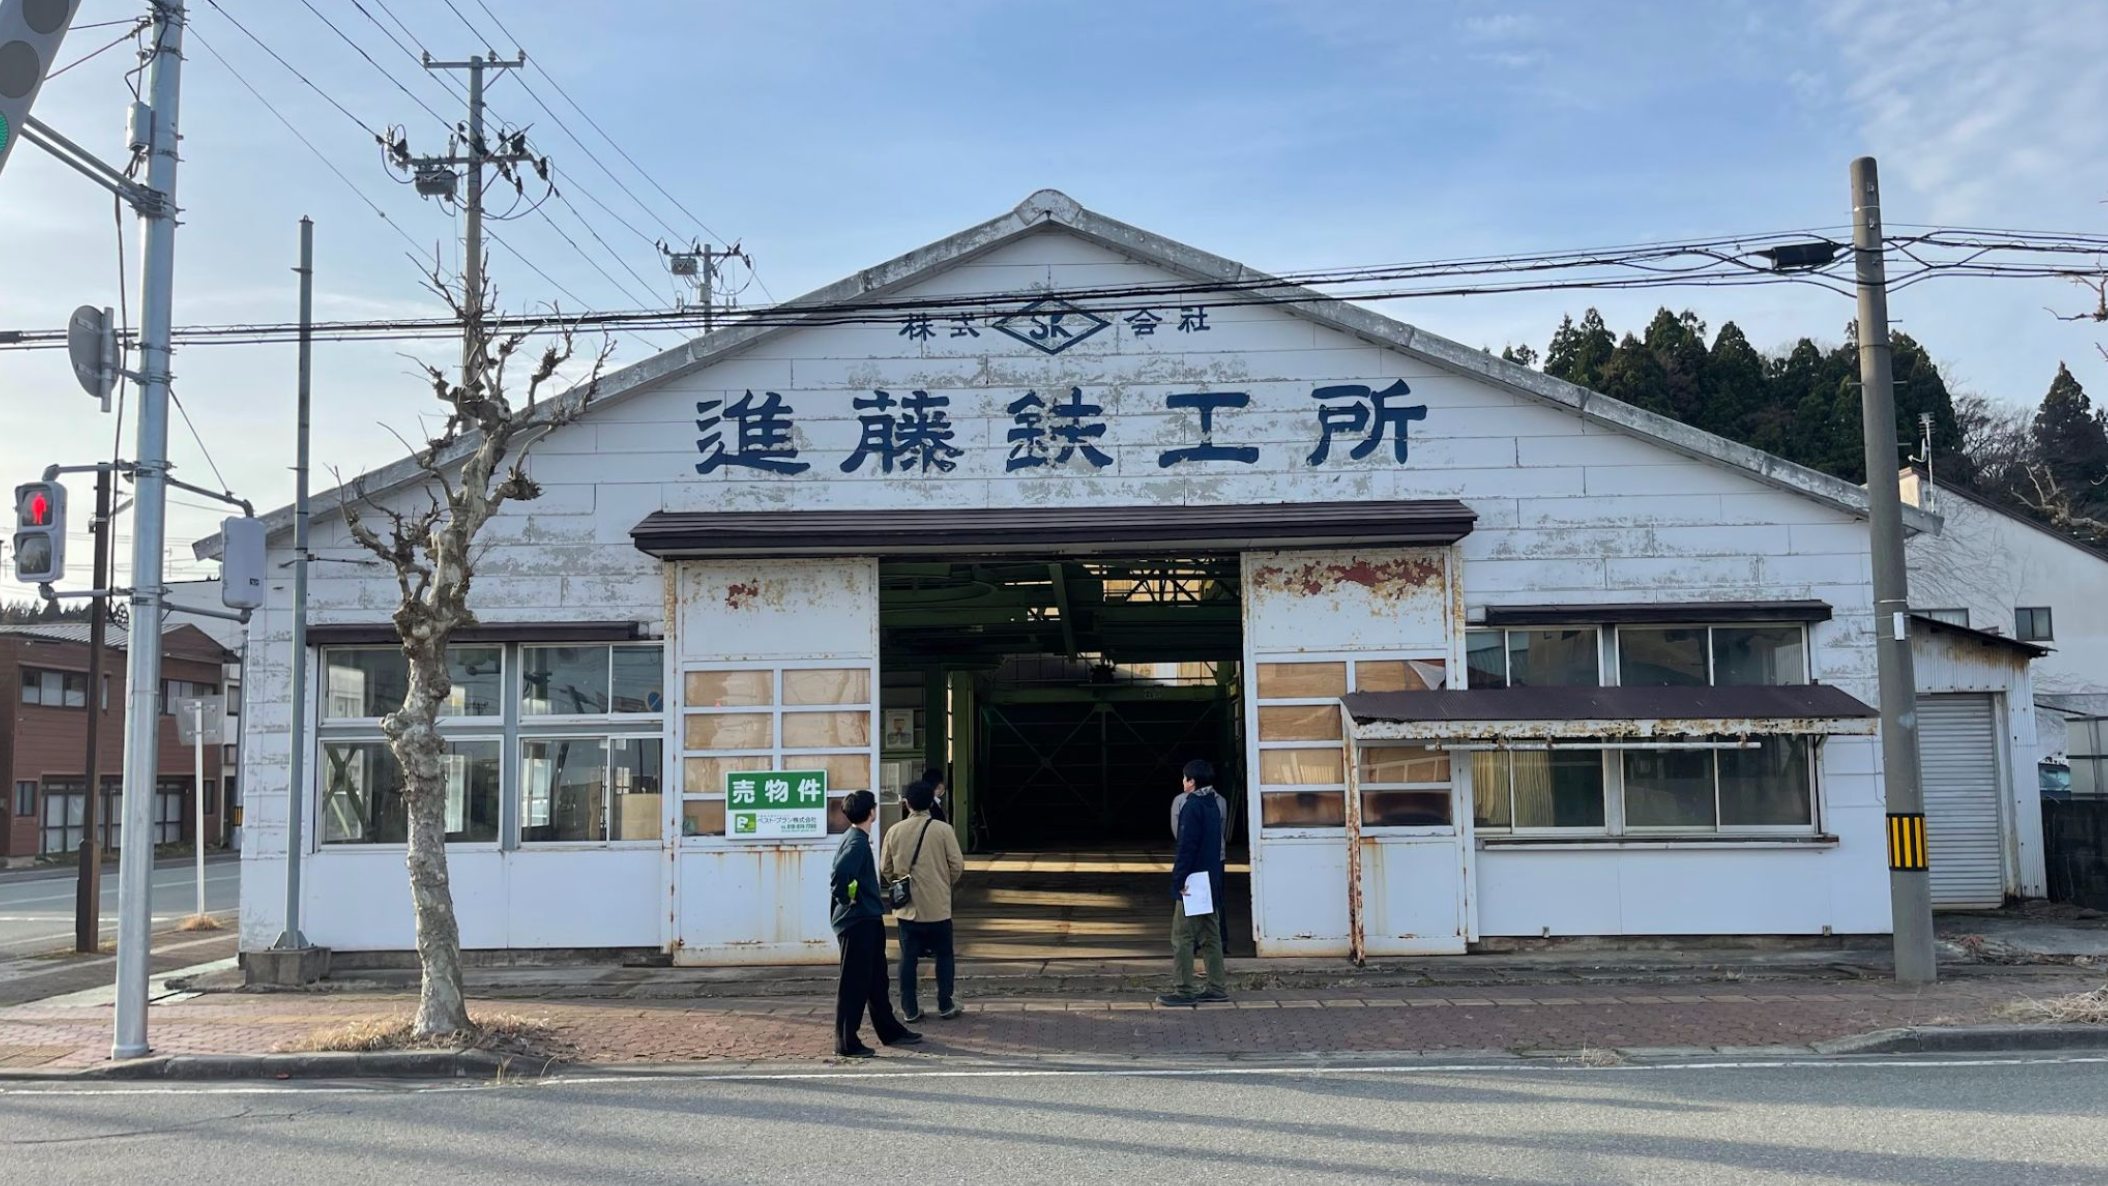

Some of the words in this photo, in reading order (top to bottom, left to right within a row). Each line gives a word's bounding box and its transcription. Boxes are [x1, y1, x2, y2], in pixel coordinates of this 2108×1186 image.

[899, 312, 981, 341] 株式
[1029, 311, 1074, 340] SK
[1123, 306, 1211, 337] 会社
[695, 378, 1429, 476] 進藤鉄工所
[732, 779, 822, 804] 売物件
